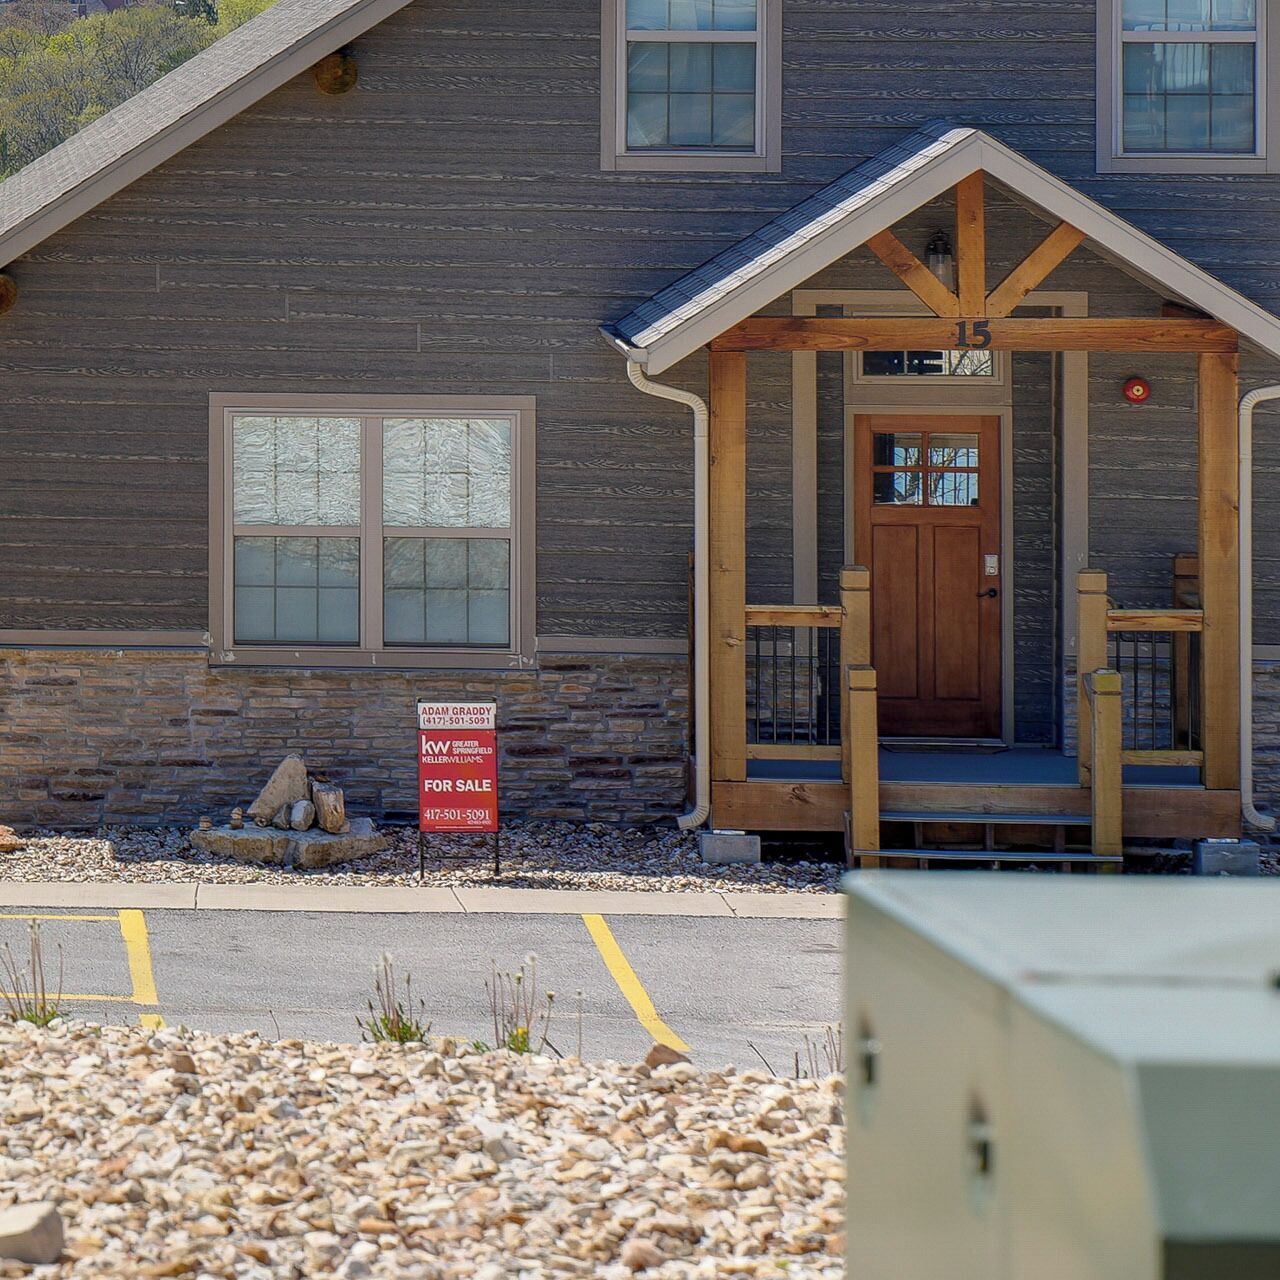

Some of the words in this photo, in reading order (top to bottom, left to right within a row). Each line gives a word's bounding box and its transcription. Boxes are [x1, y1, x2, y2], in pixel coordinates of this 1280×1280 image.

[955, 320, 992, 348] 15
[421, 706, 449, 716] ADAM
[452, 706, 492, 716] GRADDY
[423, 716, 490, 725] (417)-501-5091
[421, 734, 451, 755] kw
[452, 747, 493, 755] SPRINGFIELD
[424, 779, 453, 792] FOR
[455, 779, 492, 792] SALE
[424, 808, 490, 820] 417-501-5091
